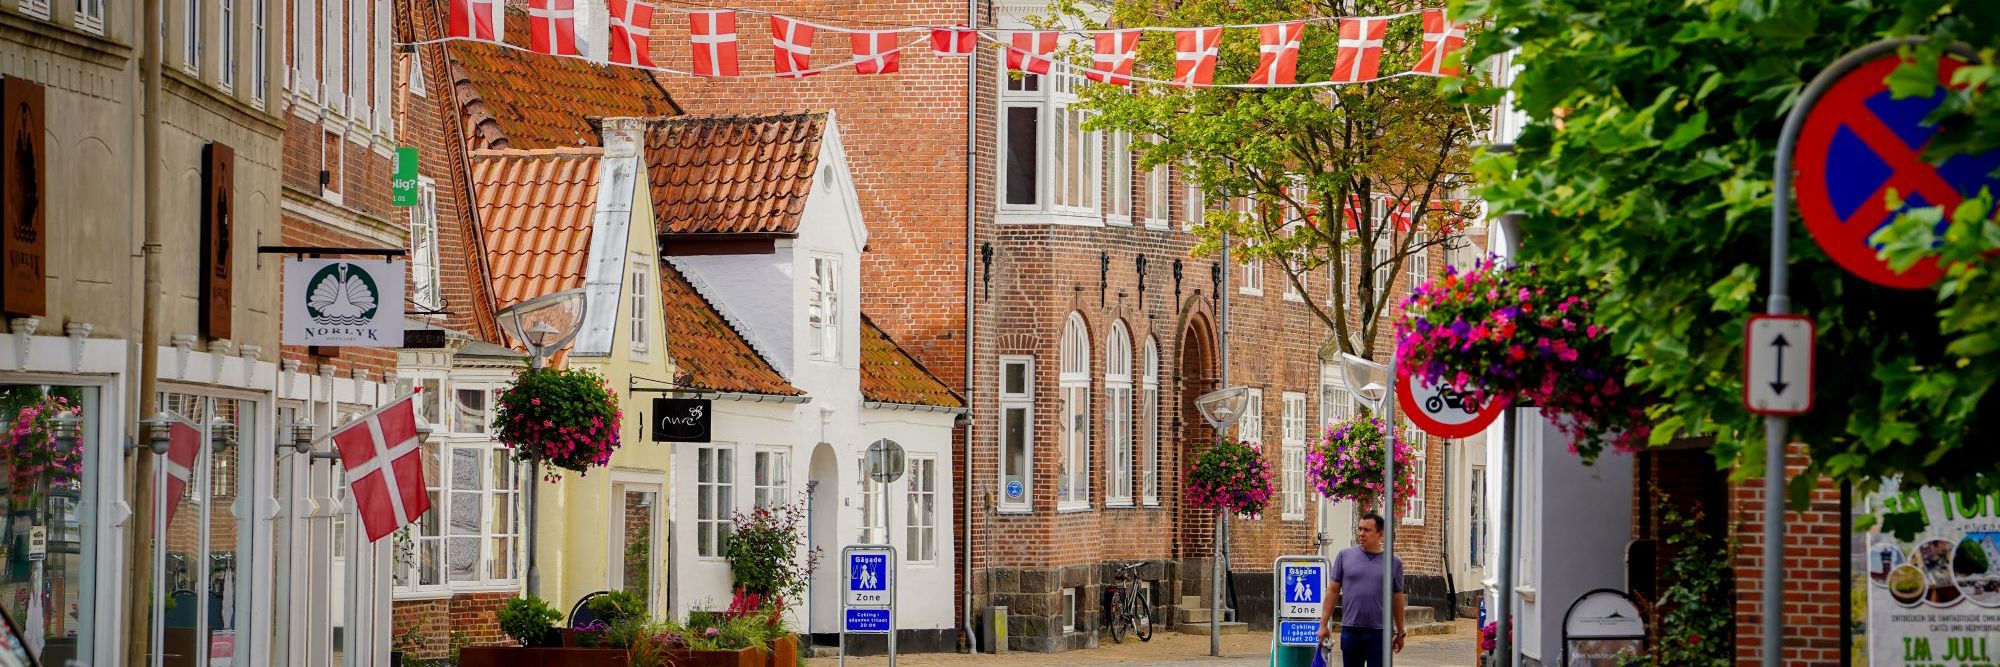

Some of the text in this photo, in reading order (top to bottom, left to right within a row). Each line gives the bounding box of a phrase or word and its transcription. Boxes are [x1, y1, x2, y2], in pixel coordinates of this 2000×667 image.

[305, 327, 378, 341] NORLYK
[856, 593, 881, 601] Zone
[1291, 605, 1316, 614] Zone
[1291, 623, 1316, 631] Cykling
[1903, 636, 1932, 661] IM
